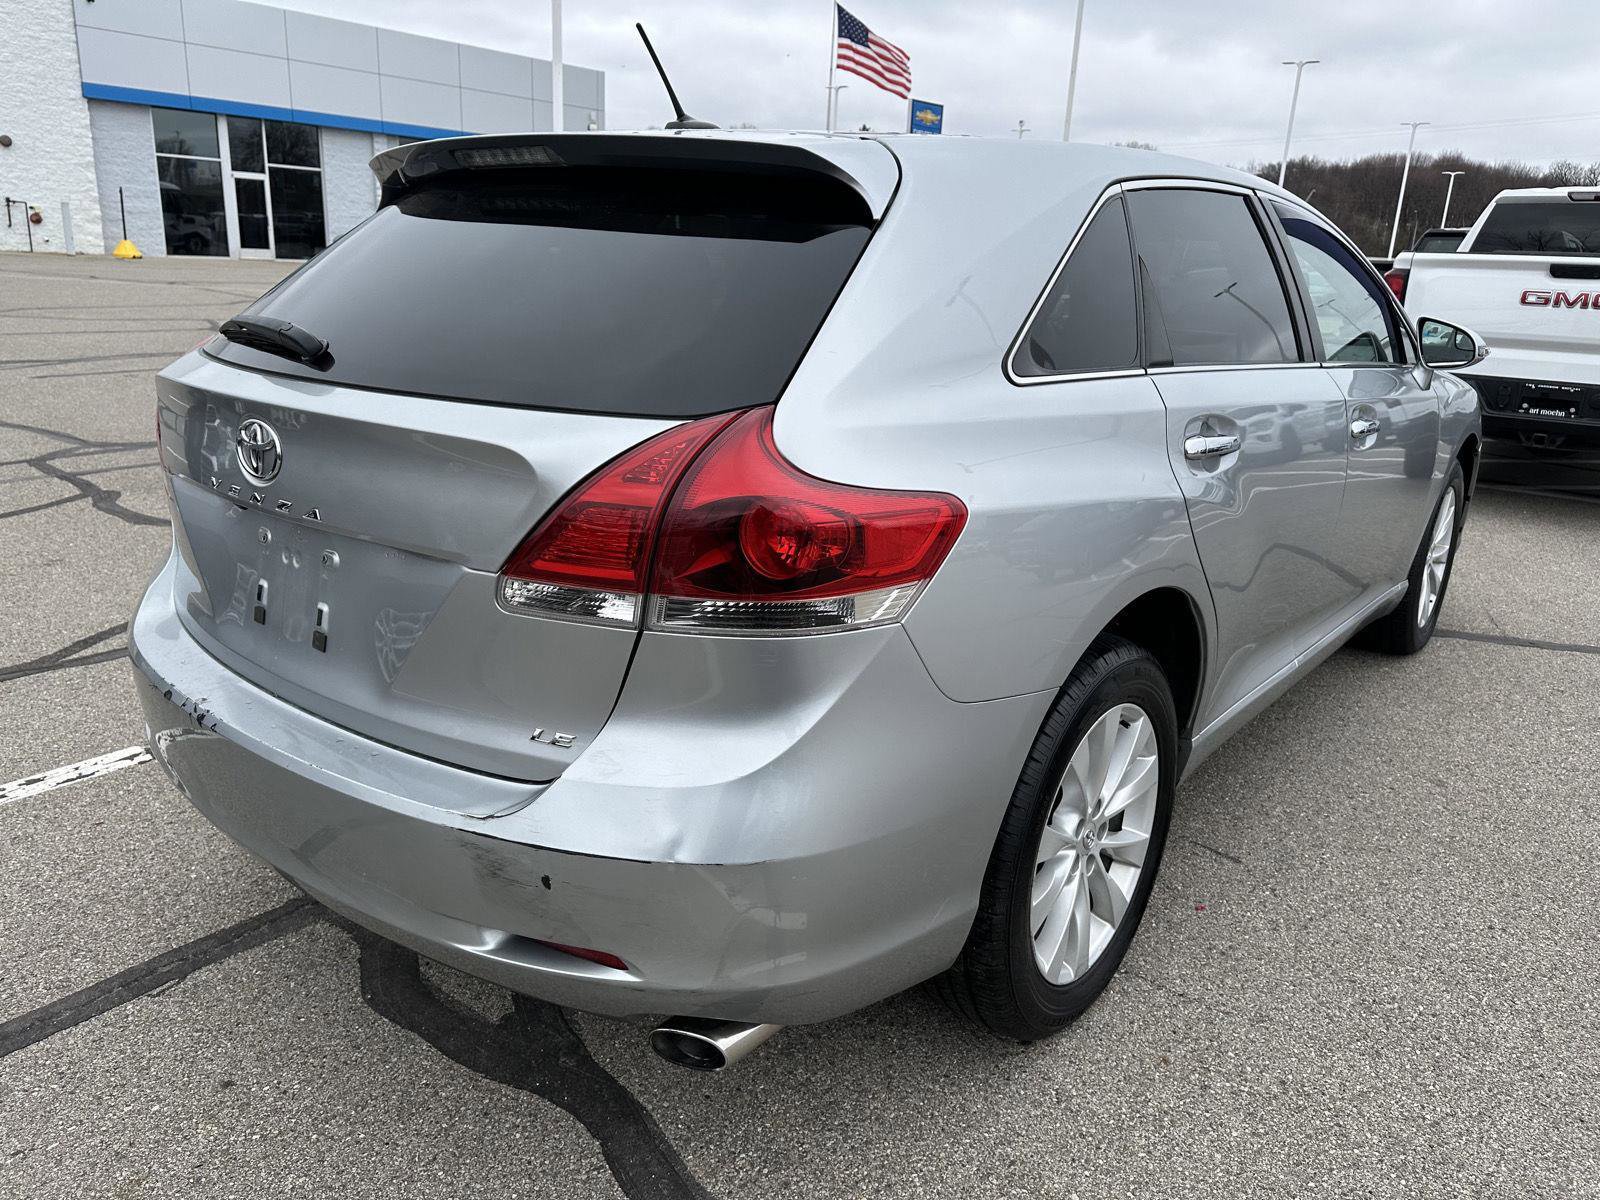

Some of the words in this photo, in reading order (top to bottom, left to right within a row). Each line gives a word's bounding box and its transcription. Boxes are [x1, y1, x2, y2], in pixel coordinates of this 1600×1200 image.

[1520, 289, 1600, 309] GM
[1540, 409, 1566, 417] moehn
[210, 476, 322, 522] VENZA
[529, 728, 577, 749] LE
